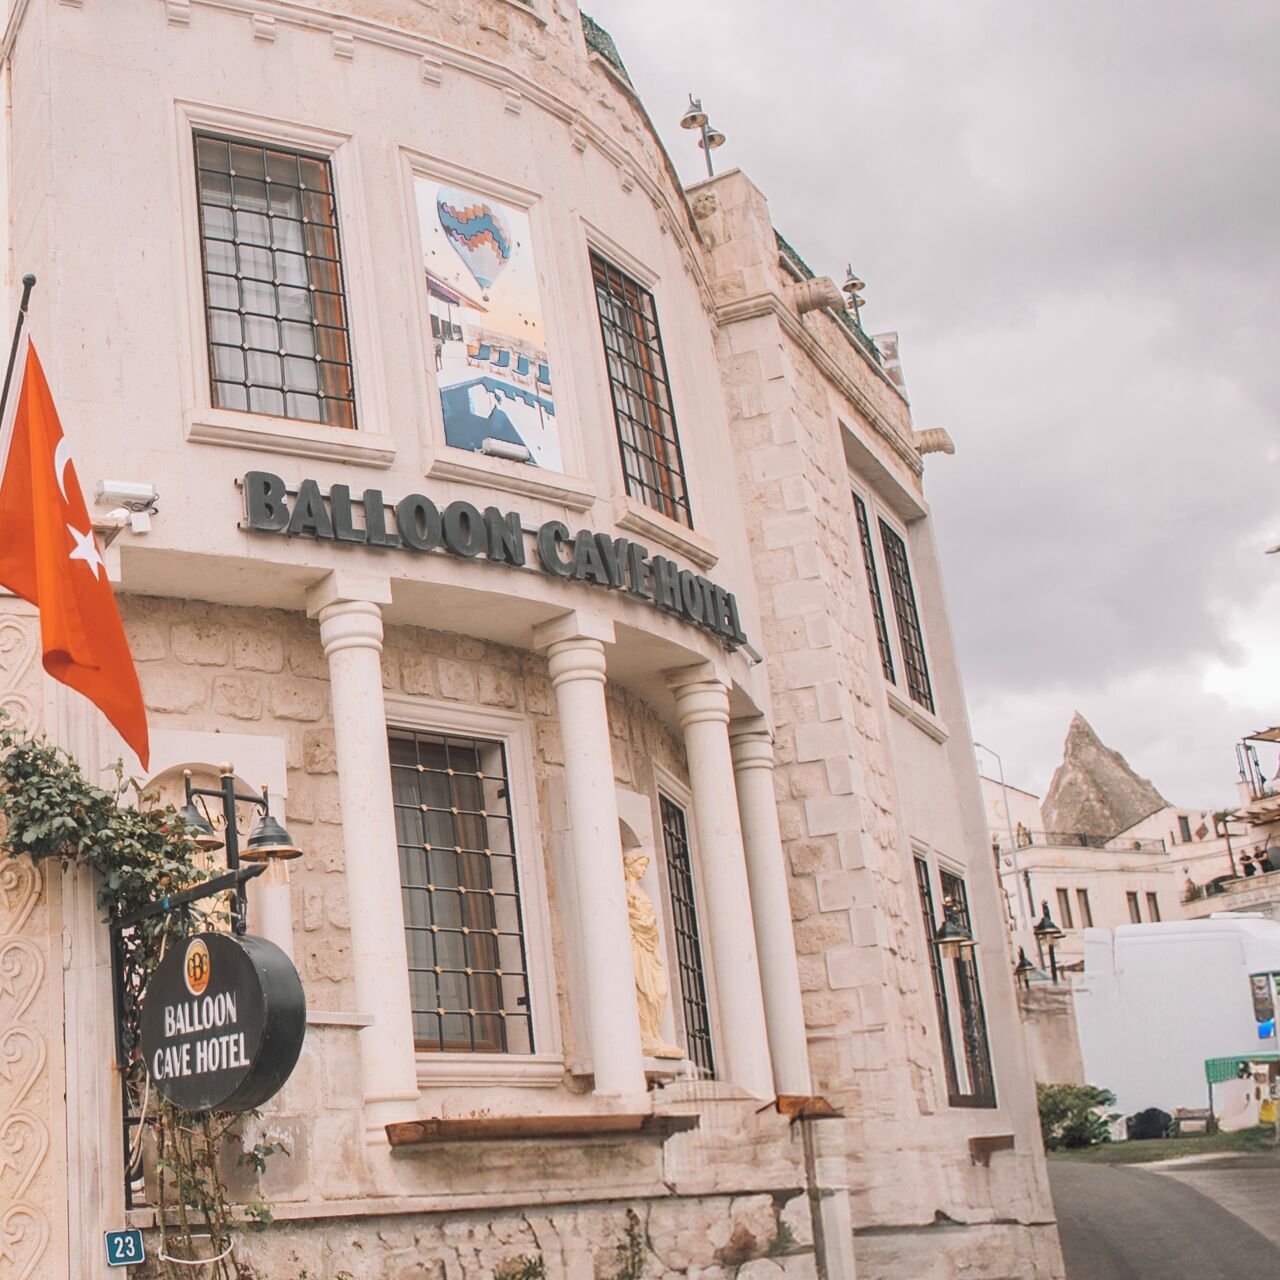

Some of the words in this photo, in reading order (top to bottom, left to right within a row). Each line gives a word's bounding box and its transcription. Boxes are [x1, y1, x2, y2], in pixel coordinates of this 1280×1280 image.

[245, 471, 525, 566] BALLOON
[537, 520, 654, 599] CAVE
[652, 554, 747, 644] HOTEL
[164, 992, 237, 1037] BALLOON
[153, 1043, 192, 1080] CAVE
[196, 1032, 250, 1074] HOTEL
[114, 1236, 135, 1258] 23
